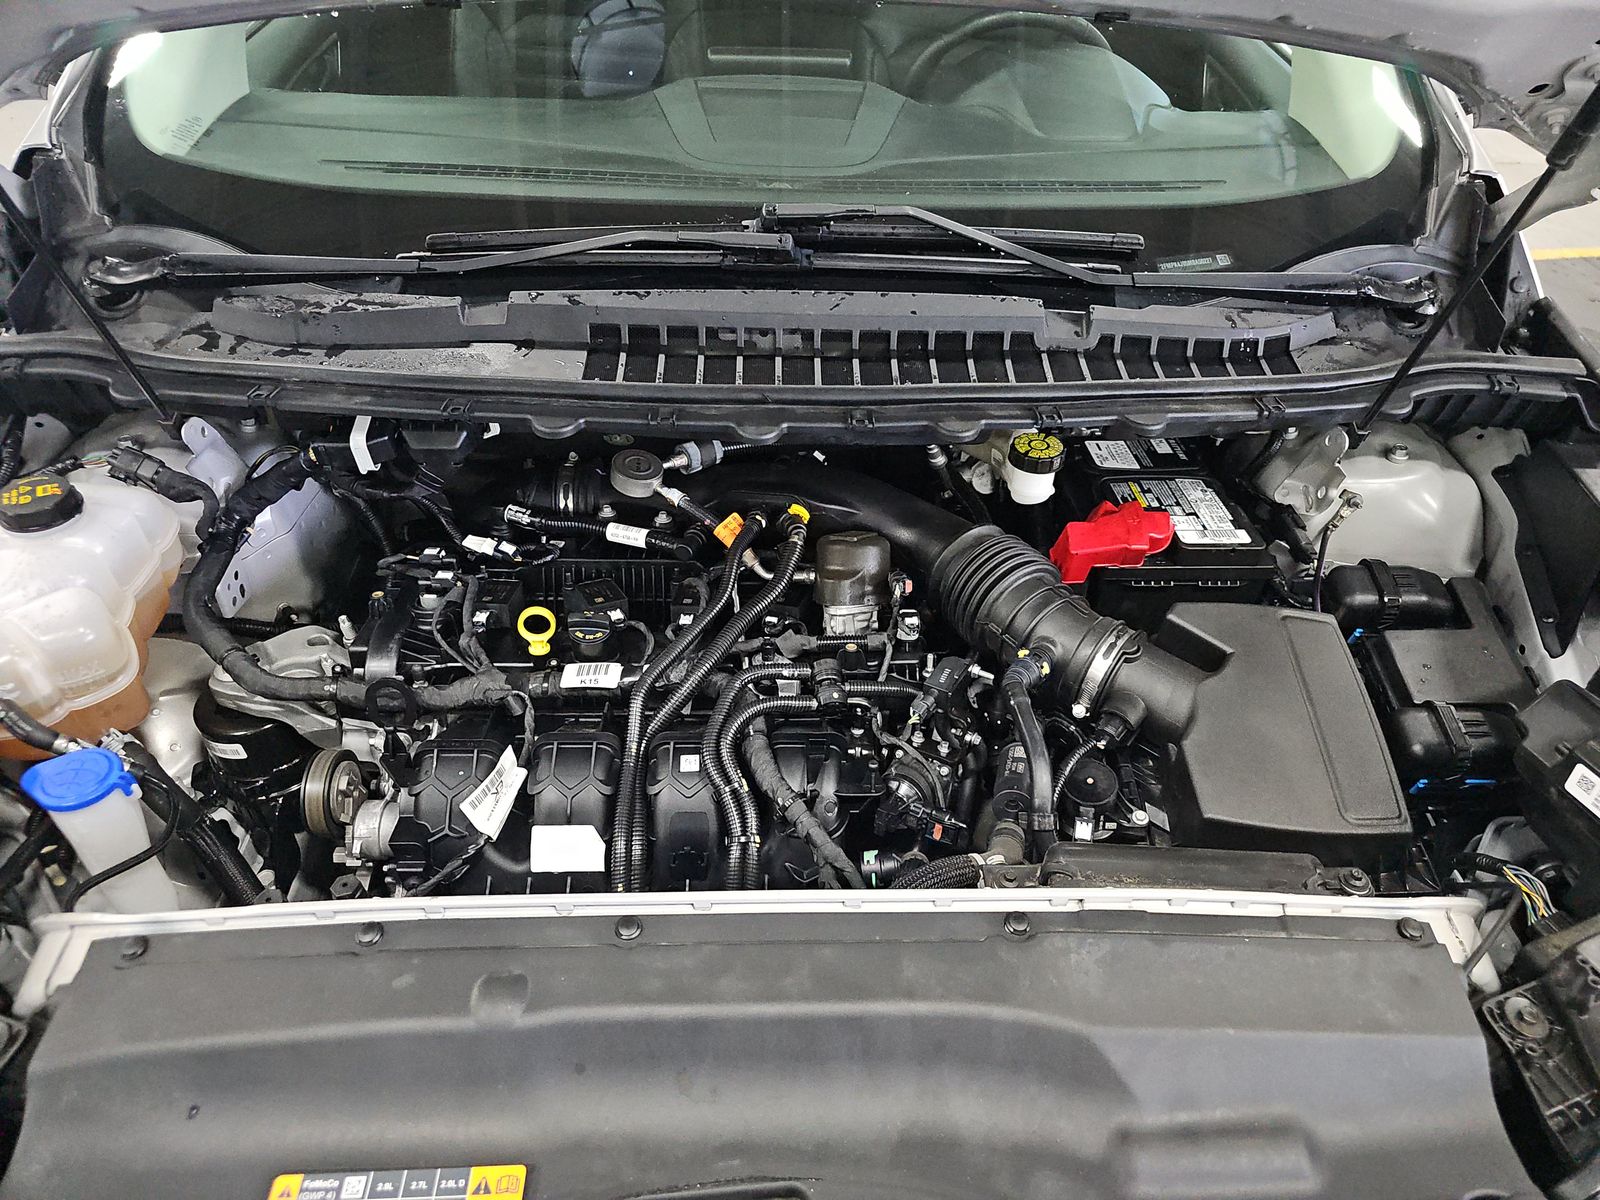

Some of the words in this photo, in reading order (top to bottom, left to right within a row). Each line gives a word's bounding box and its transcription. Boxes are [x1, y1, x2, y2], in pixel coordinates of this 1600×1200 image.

[303, 1178, 340, 1189] FoMoCo
[410, 1180, 428, 1191] 2.7L
[457, 1178, 466, 1188] D
